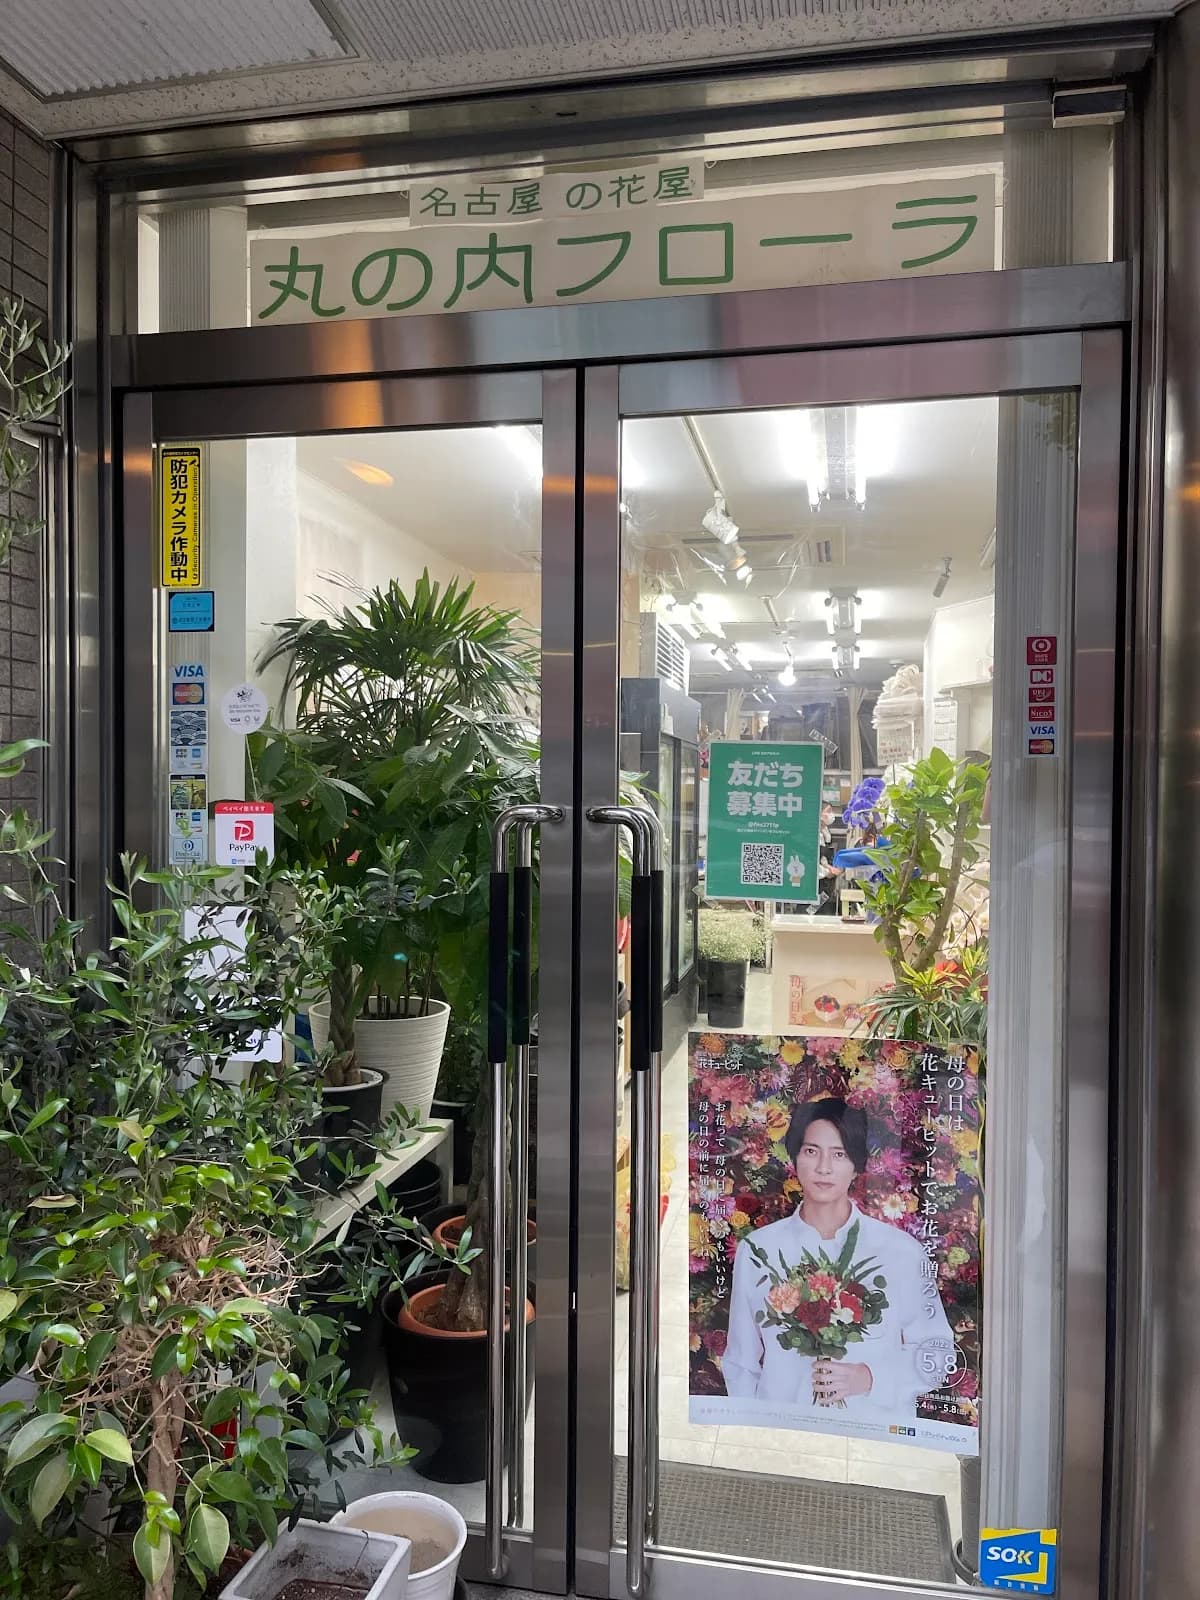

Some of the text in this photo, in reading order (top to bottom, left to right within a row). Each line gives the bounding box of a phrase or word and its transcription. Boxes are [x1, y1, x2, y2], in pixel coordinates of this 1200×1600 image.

[420, 166, 693, 217] 名古屋 の花屋
[258, 194, 978, 319] 丸の内フローラ
[170, 459, 188, 582] 防犯カメラ作動中
[175, 665, 204, 678] VISA
[1030, 726, 1055, 735] VISA
[727, 760, 804, 788] 友だち
[727, 791, 802, 818] 募集中
[947, 1055, 966, 1131] 母の日は
[920, 1053, 940, 1320] 花キューピットでお花を贈ろう
[922, 1352, 957, 1374] 5.8
[986, 1546, 1034, 1566] SOK
